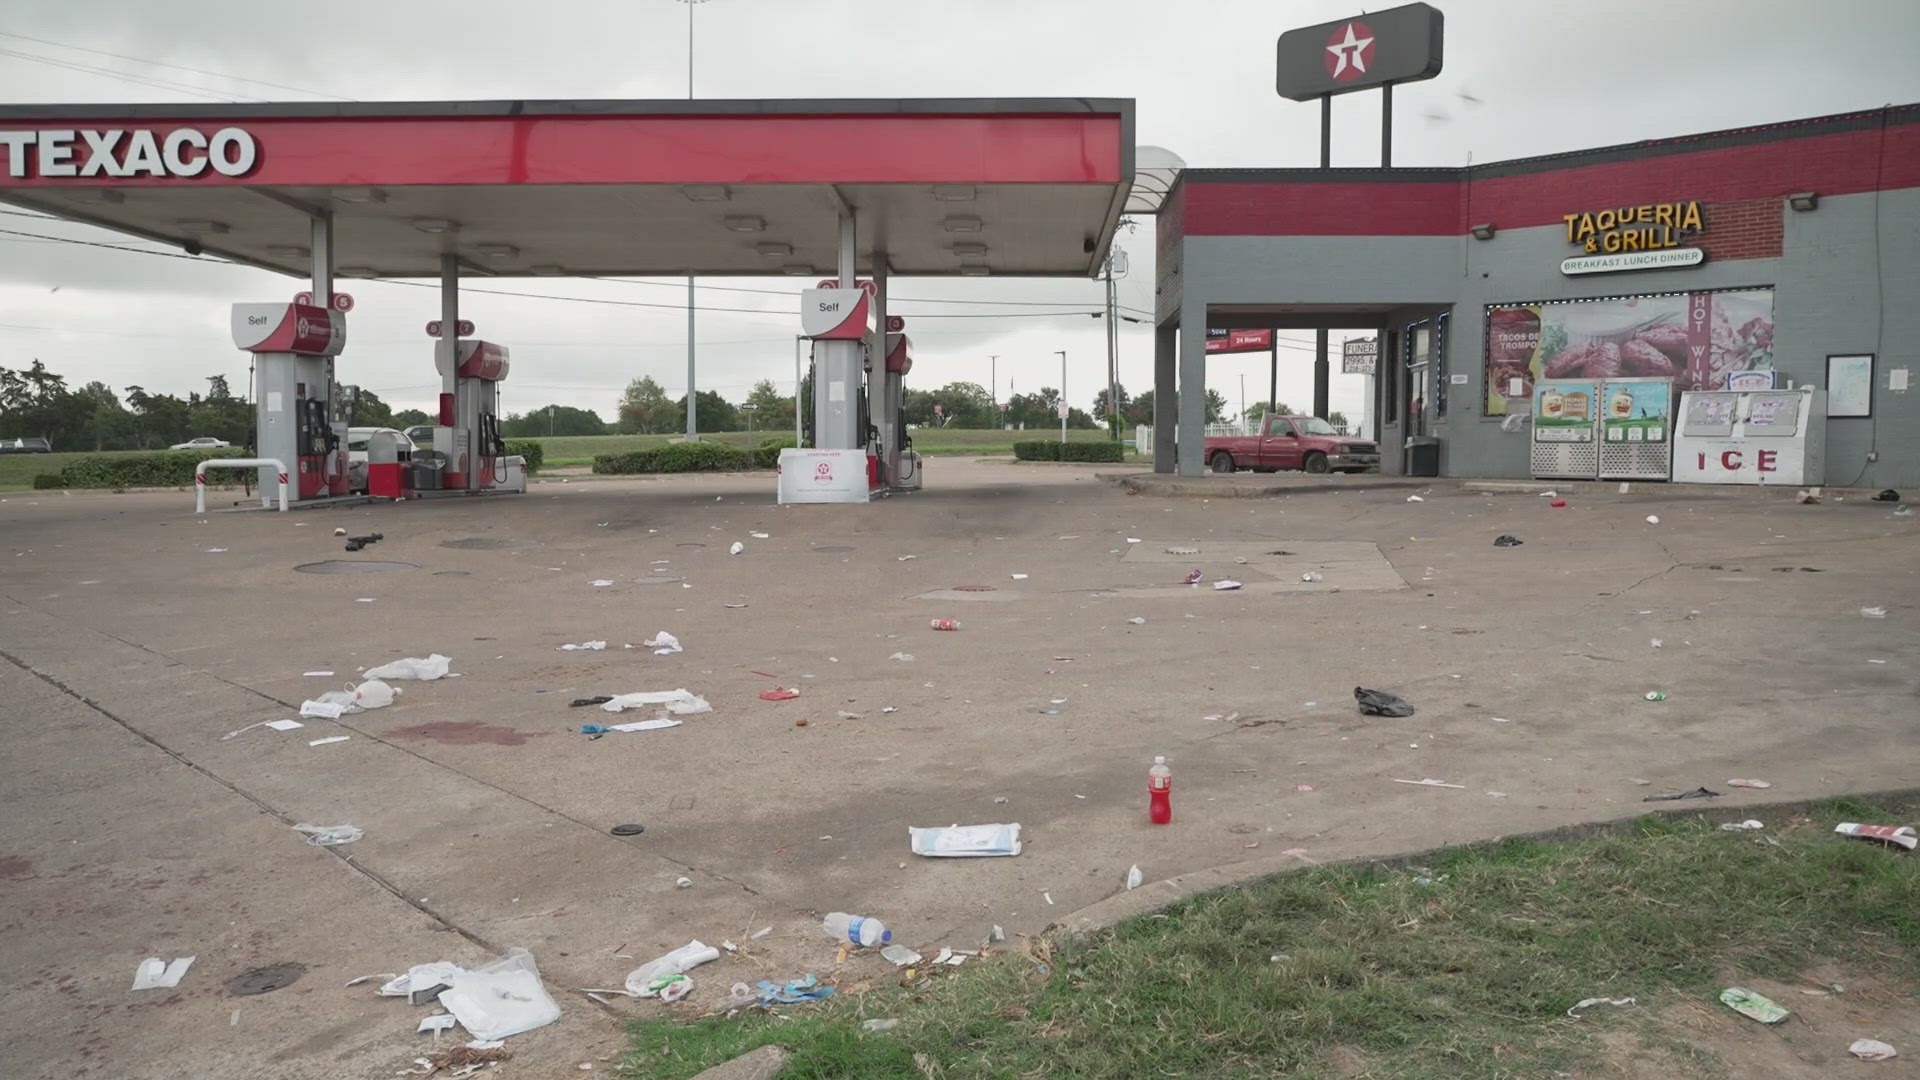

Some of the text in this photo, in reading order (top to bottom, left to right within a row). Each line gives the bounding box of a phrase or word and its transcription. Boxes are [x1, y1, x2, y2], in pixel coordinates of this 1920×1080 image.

[0, 127, 256, 177] TEXACO
[1563, 201, 1703, 242] TAQUERIA
[1584, 227, 1678, 253] & GRILL
[1564, 251, 1699, 271] BREAKFAST LUNCH DINNER
[340, 298, 348, 307] 5
[819, 303, 839, 312] Self
[248, 316, 267, 326] Self
[1693, 296, 1706, 333] HOT
[1498, 332, 1539, 342] TACOS DE
[1500, 341, 1537, 350] TROMPO
[1698, 449, 1778, 472] ICE
